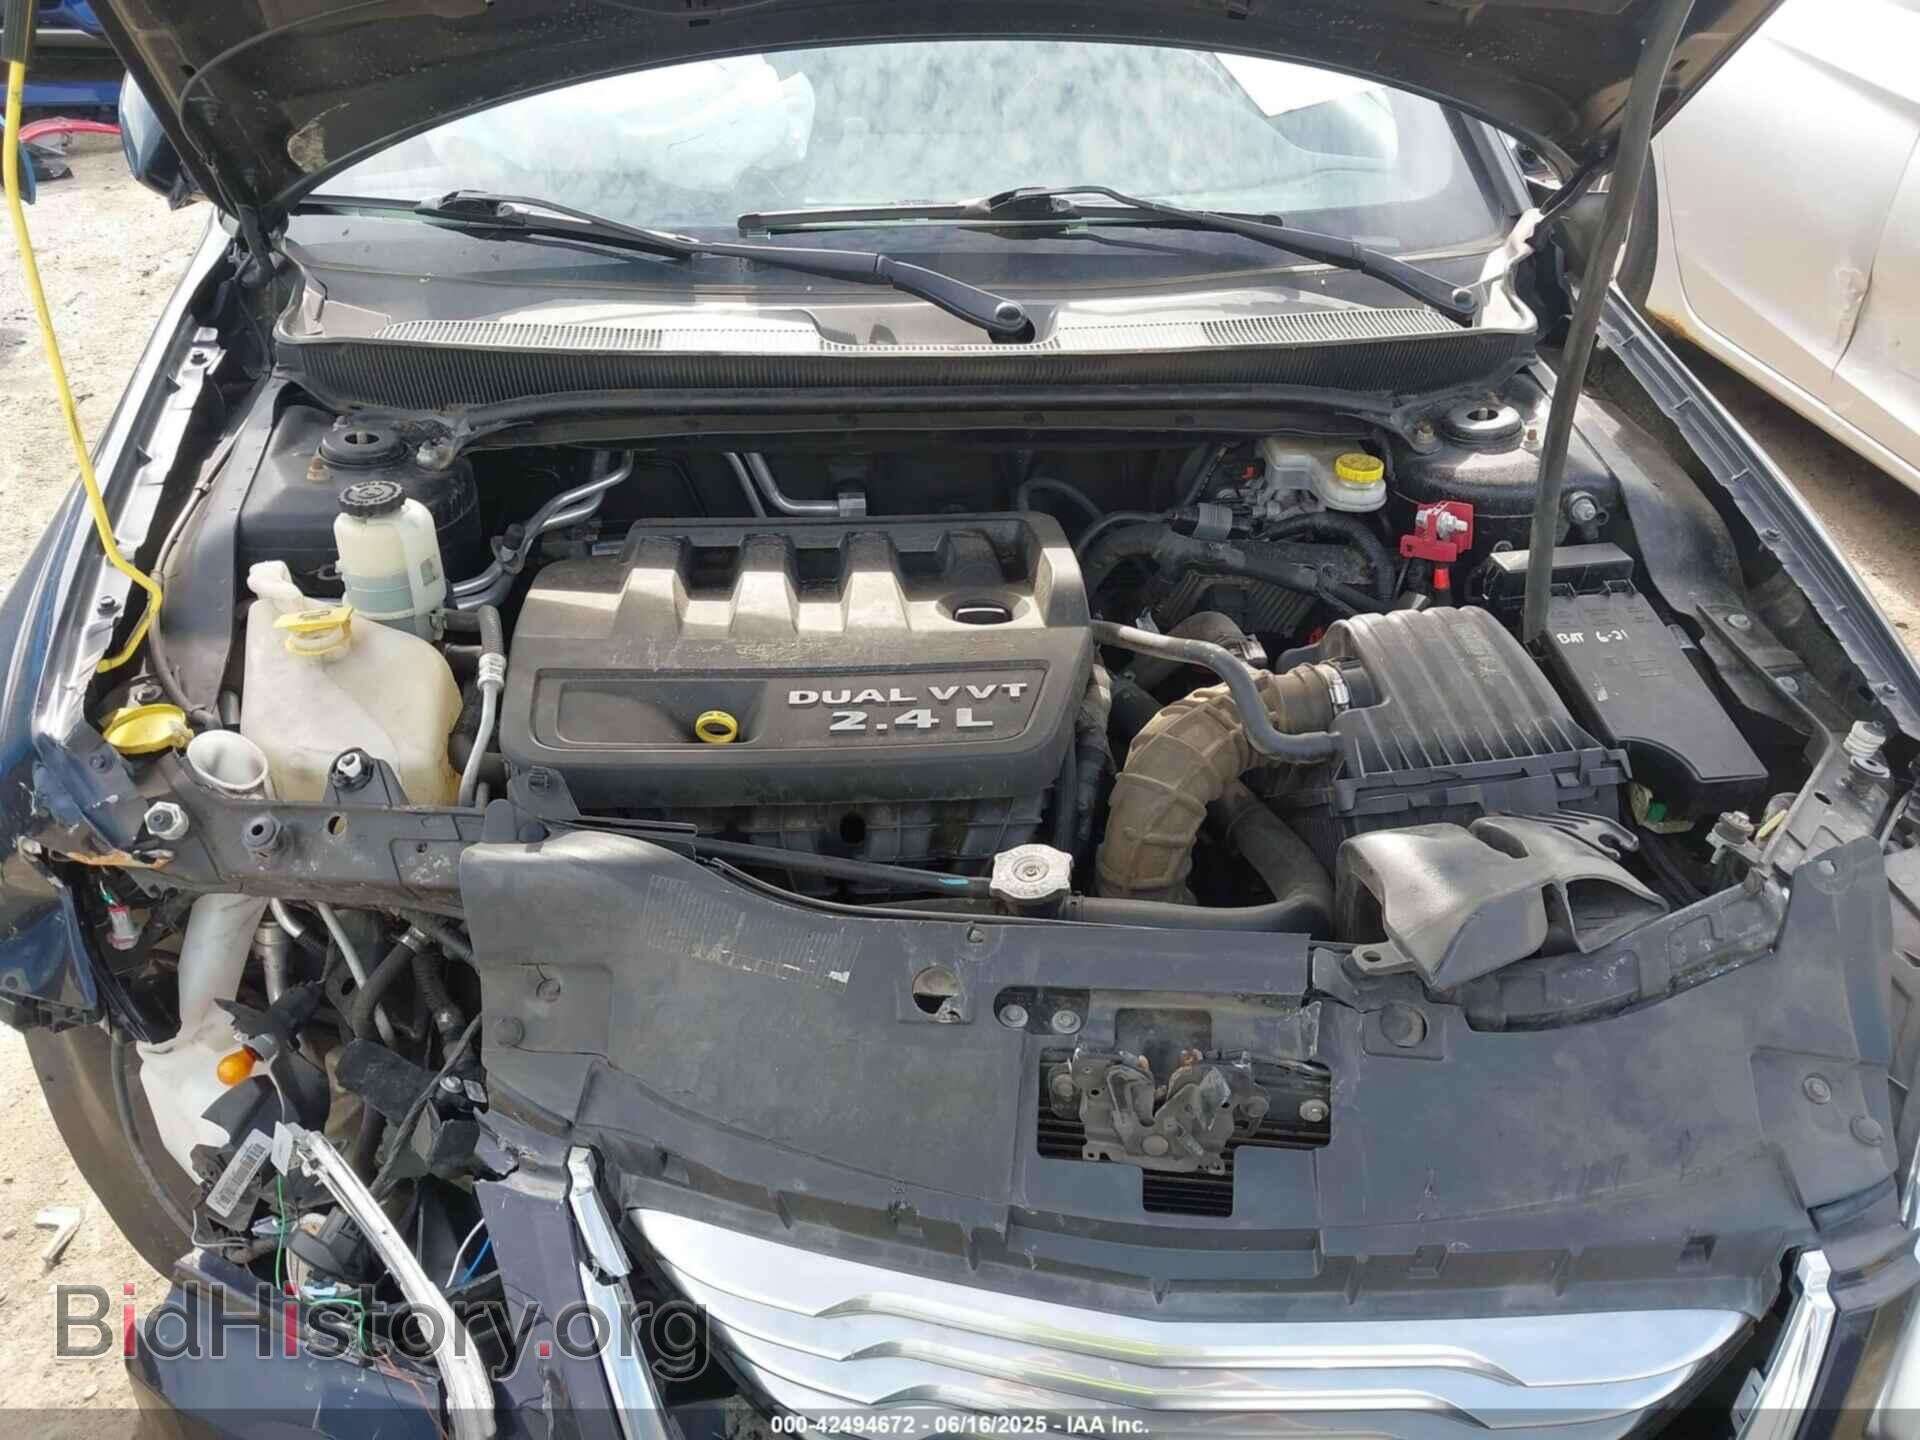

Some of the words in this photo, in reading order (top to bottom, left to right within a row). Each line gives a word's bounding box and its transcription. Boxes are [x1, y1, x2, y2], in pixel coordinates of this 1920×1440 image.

[1556, 631, 1585, 645] BAT
[788, 687, 918, 706] DUAL
[928, 682, 1028, 701] VVT
